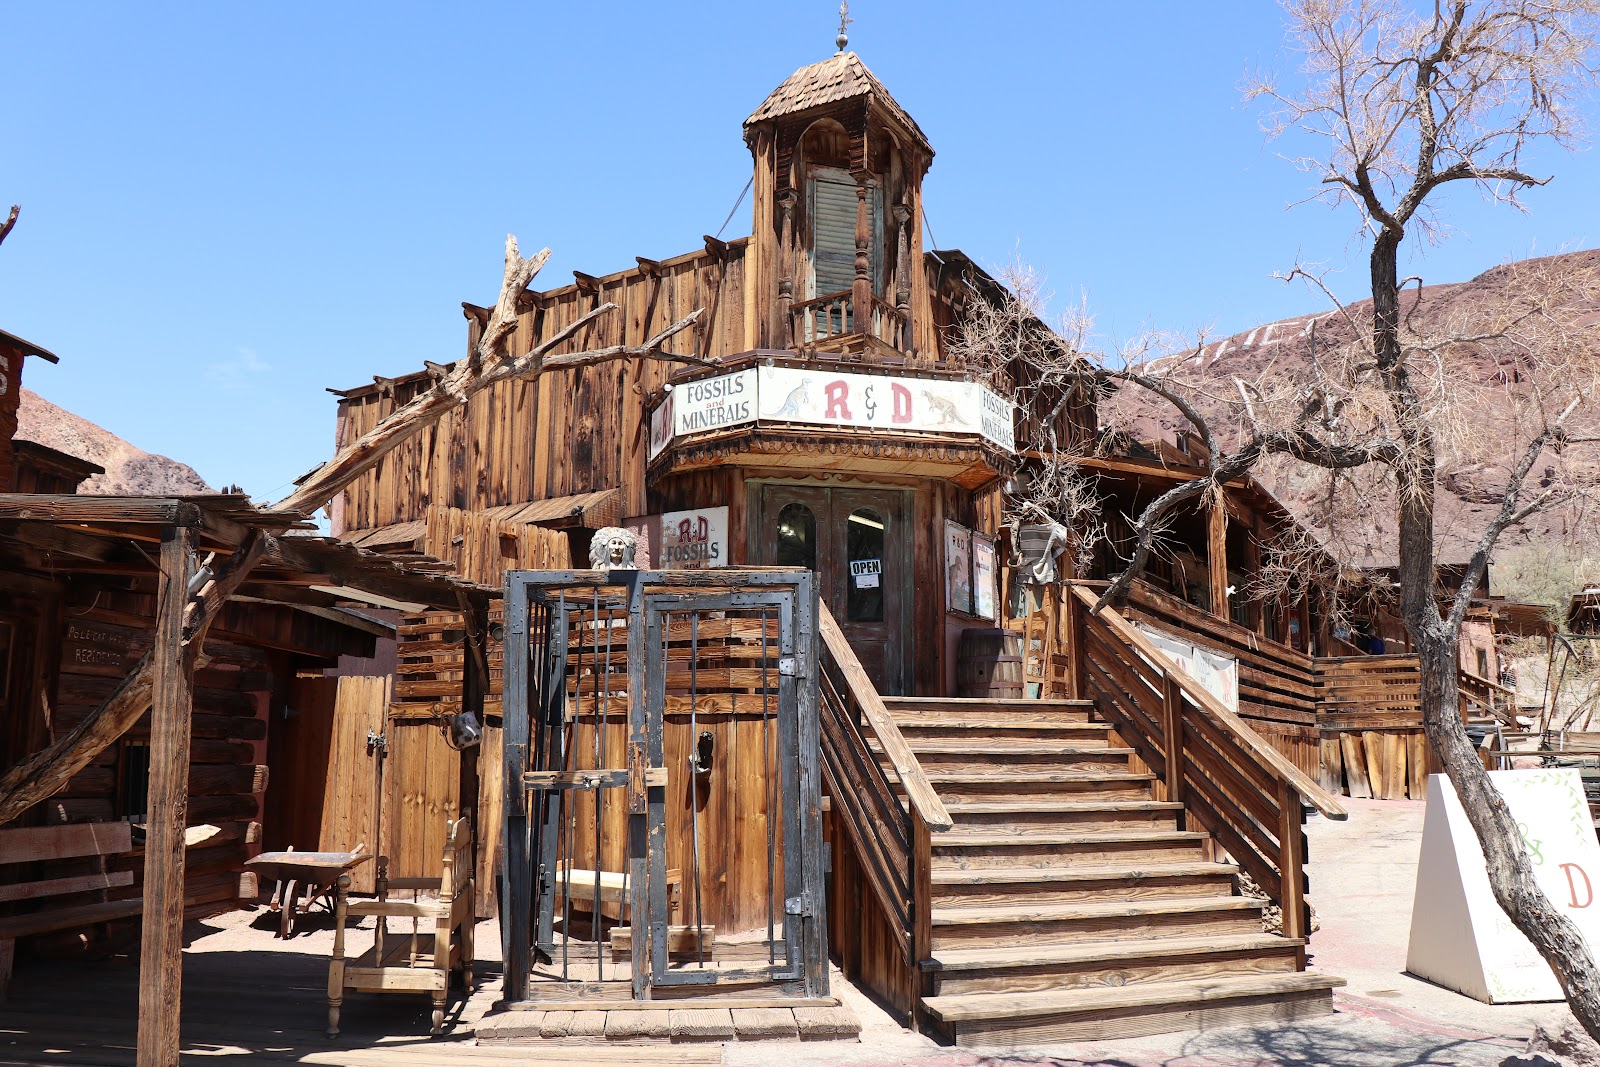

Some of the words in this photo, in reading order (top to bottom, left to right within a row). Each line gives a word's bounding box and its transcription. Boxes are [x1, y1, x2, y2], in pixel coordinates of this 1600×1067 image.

[687, 375, 744, 404] FOSSILS
[706, 397, 725, 409] and
[825, 379, 852, 420] R
[864, 384, 878, 421] &
[891, 382, 913, 424] D
[682, 400, 750, 432] MINERALS
[983, 390, 1010, 422] FOSSILS
[981, 414, 1014, 448] MINERALS
[679, 518, 692, 543] R
[697, 516, 709, 542] D
[667, 541, 719, 563] FOSSILS
[684, 560, 701, 570] and
[852, 560, 880, 575] OPEN
[1558, 862, 1594, 909] D
